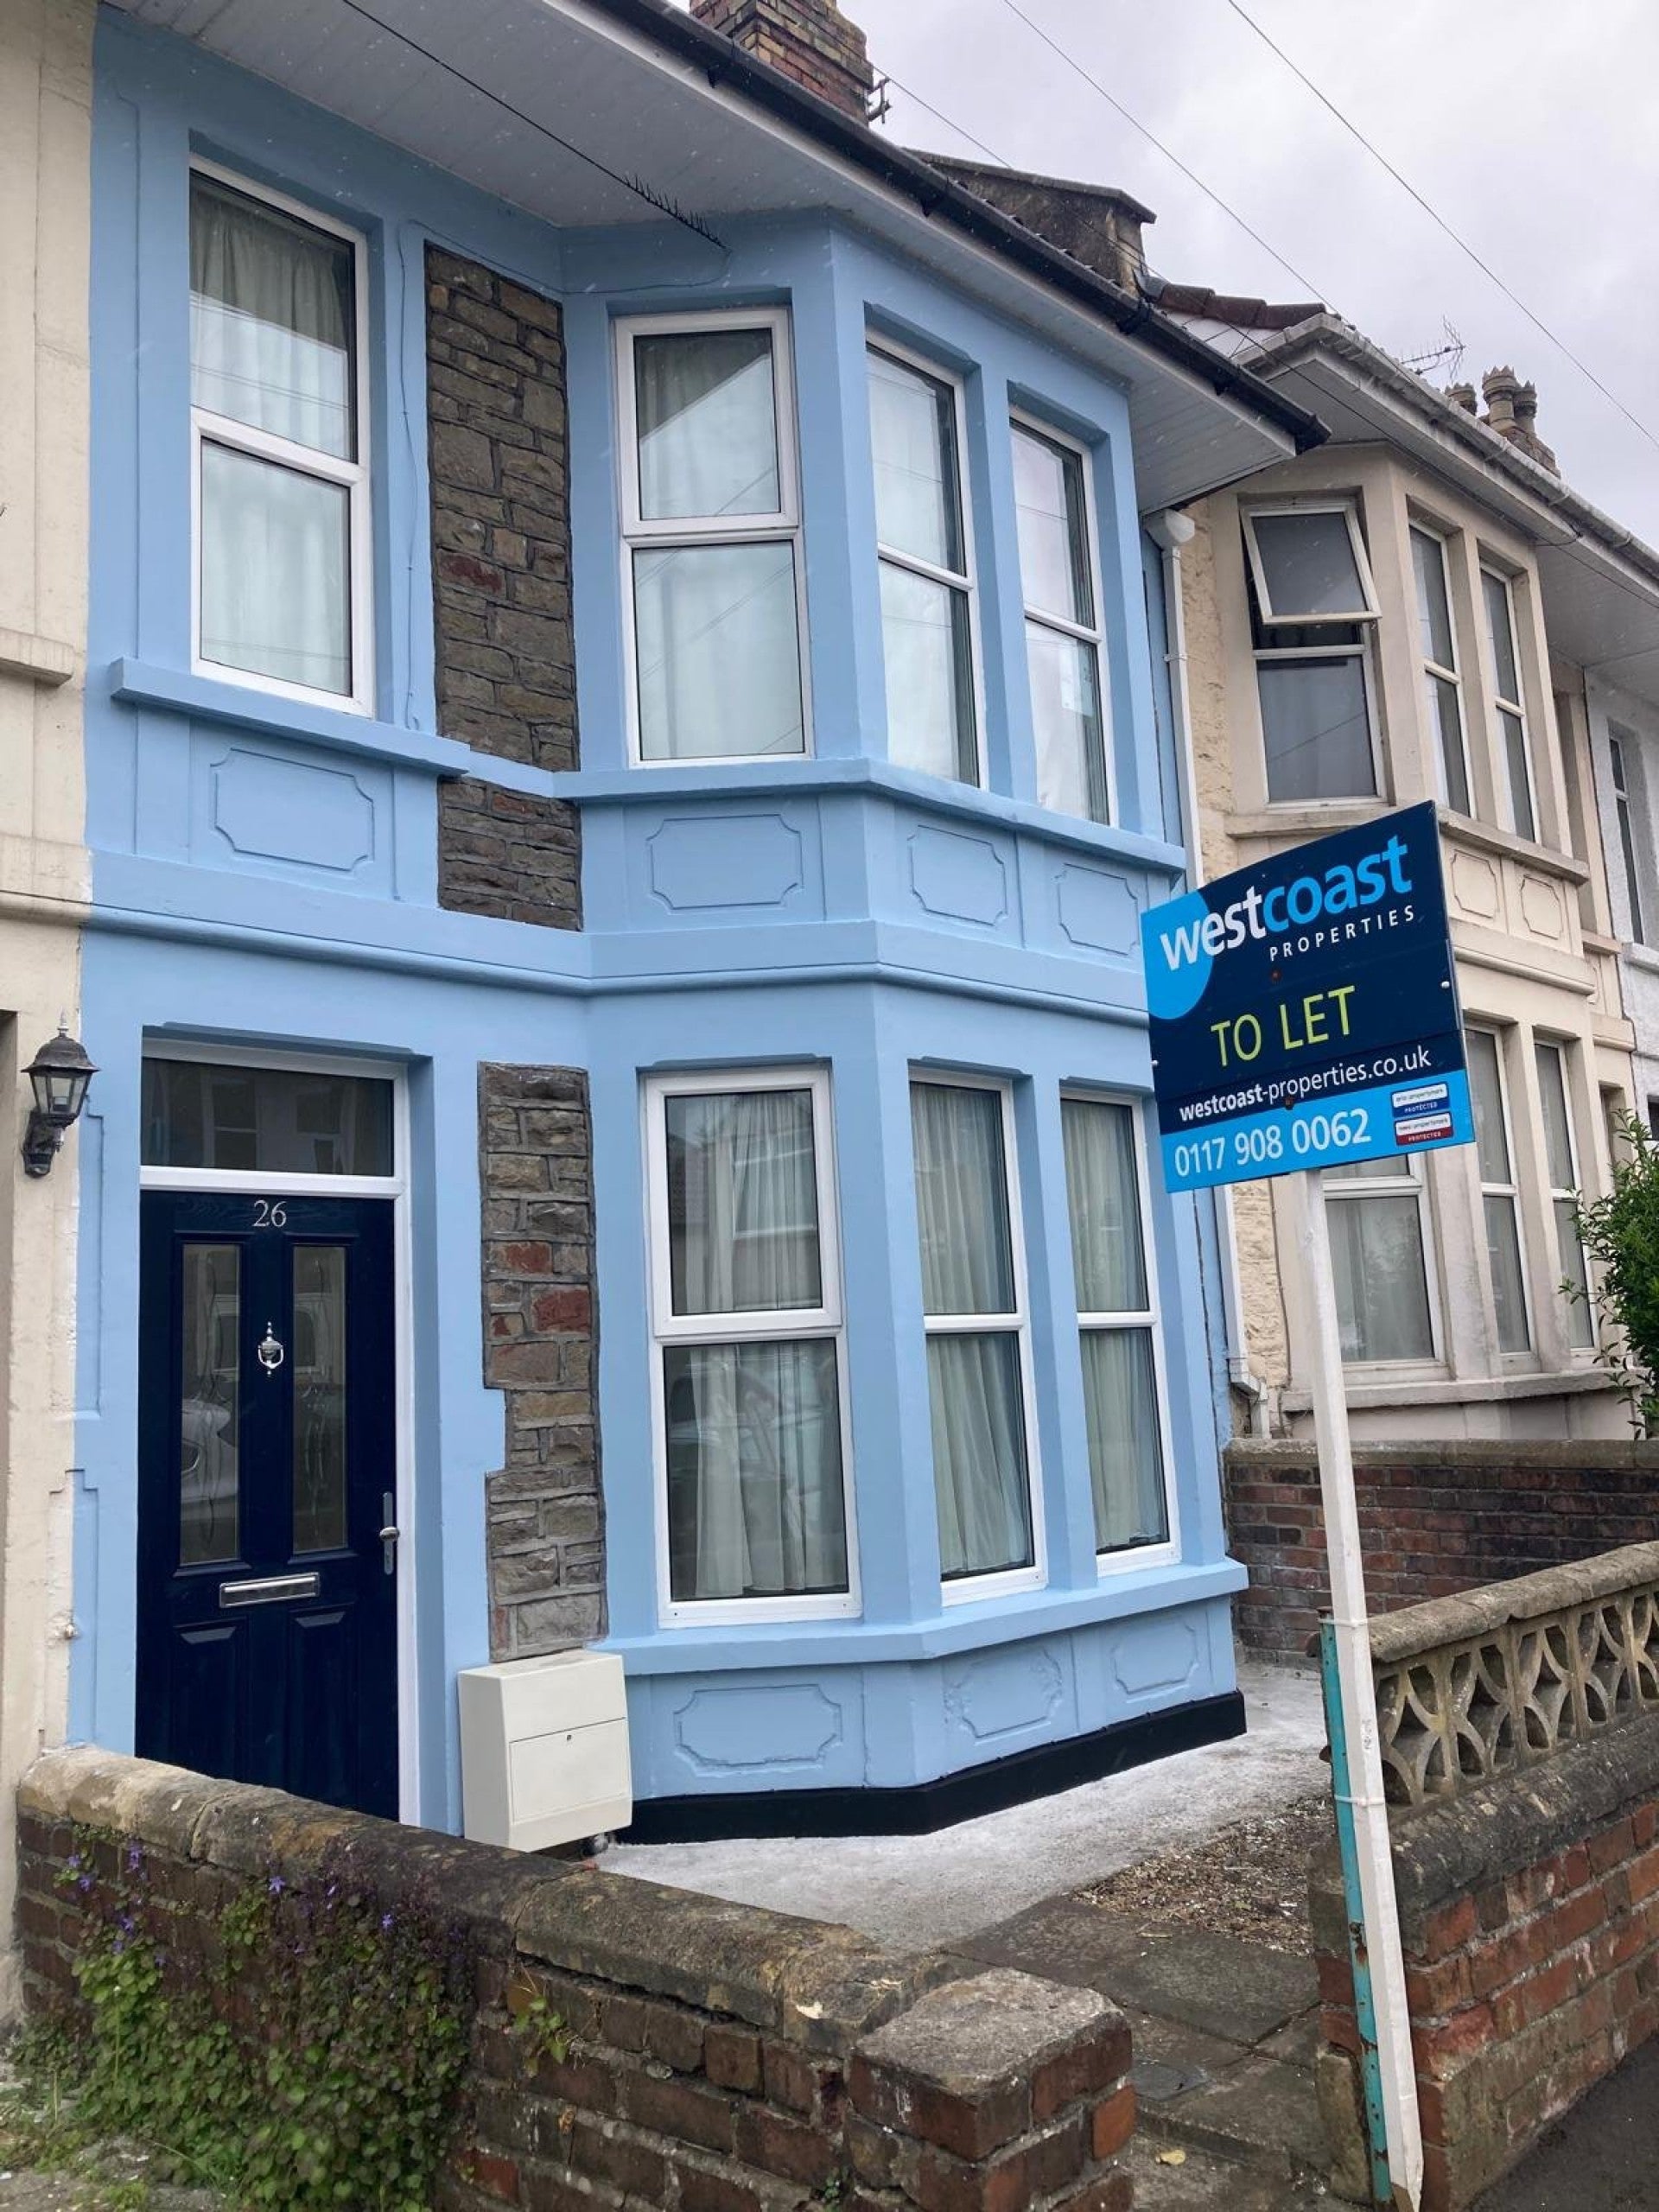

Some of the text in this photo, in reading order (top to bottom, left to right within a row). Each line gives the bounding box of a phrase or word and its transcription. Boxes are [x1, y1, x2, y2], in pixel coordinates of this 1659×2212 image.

[1269, 905, 1414, 962] PROPERTIES
[1211, 985, 1356, 1066] TO LET
[1179, 1046, 1431, 1122] westcoast-properties.co.uk
[1174, 1108, 1372, 1177] 0117 908 0062
[252, 1200, 288, 1227] 26
